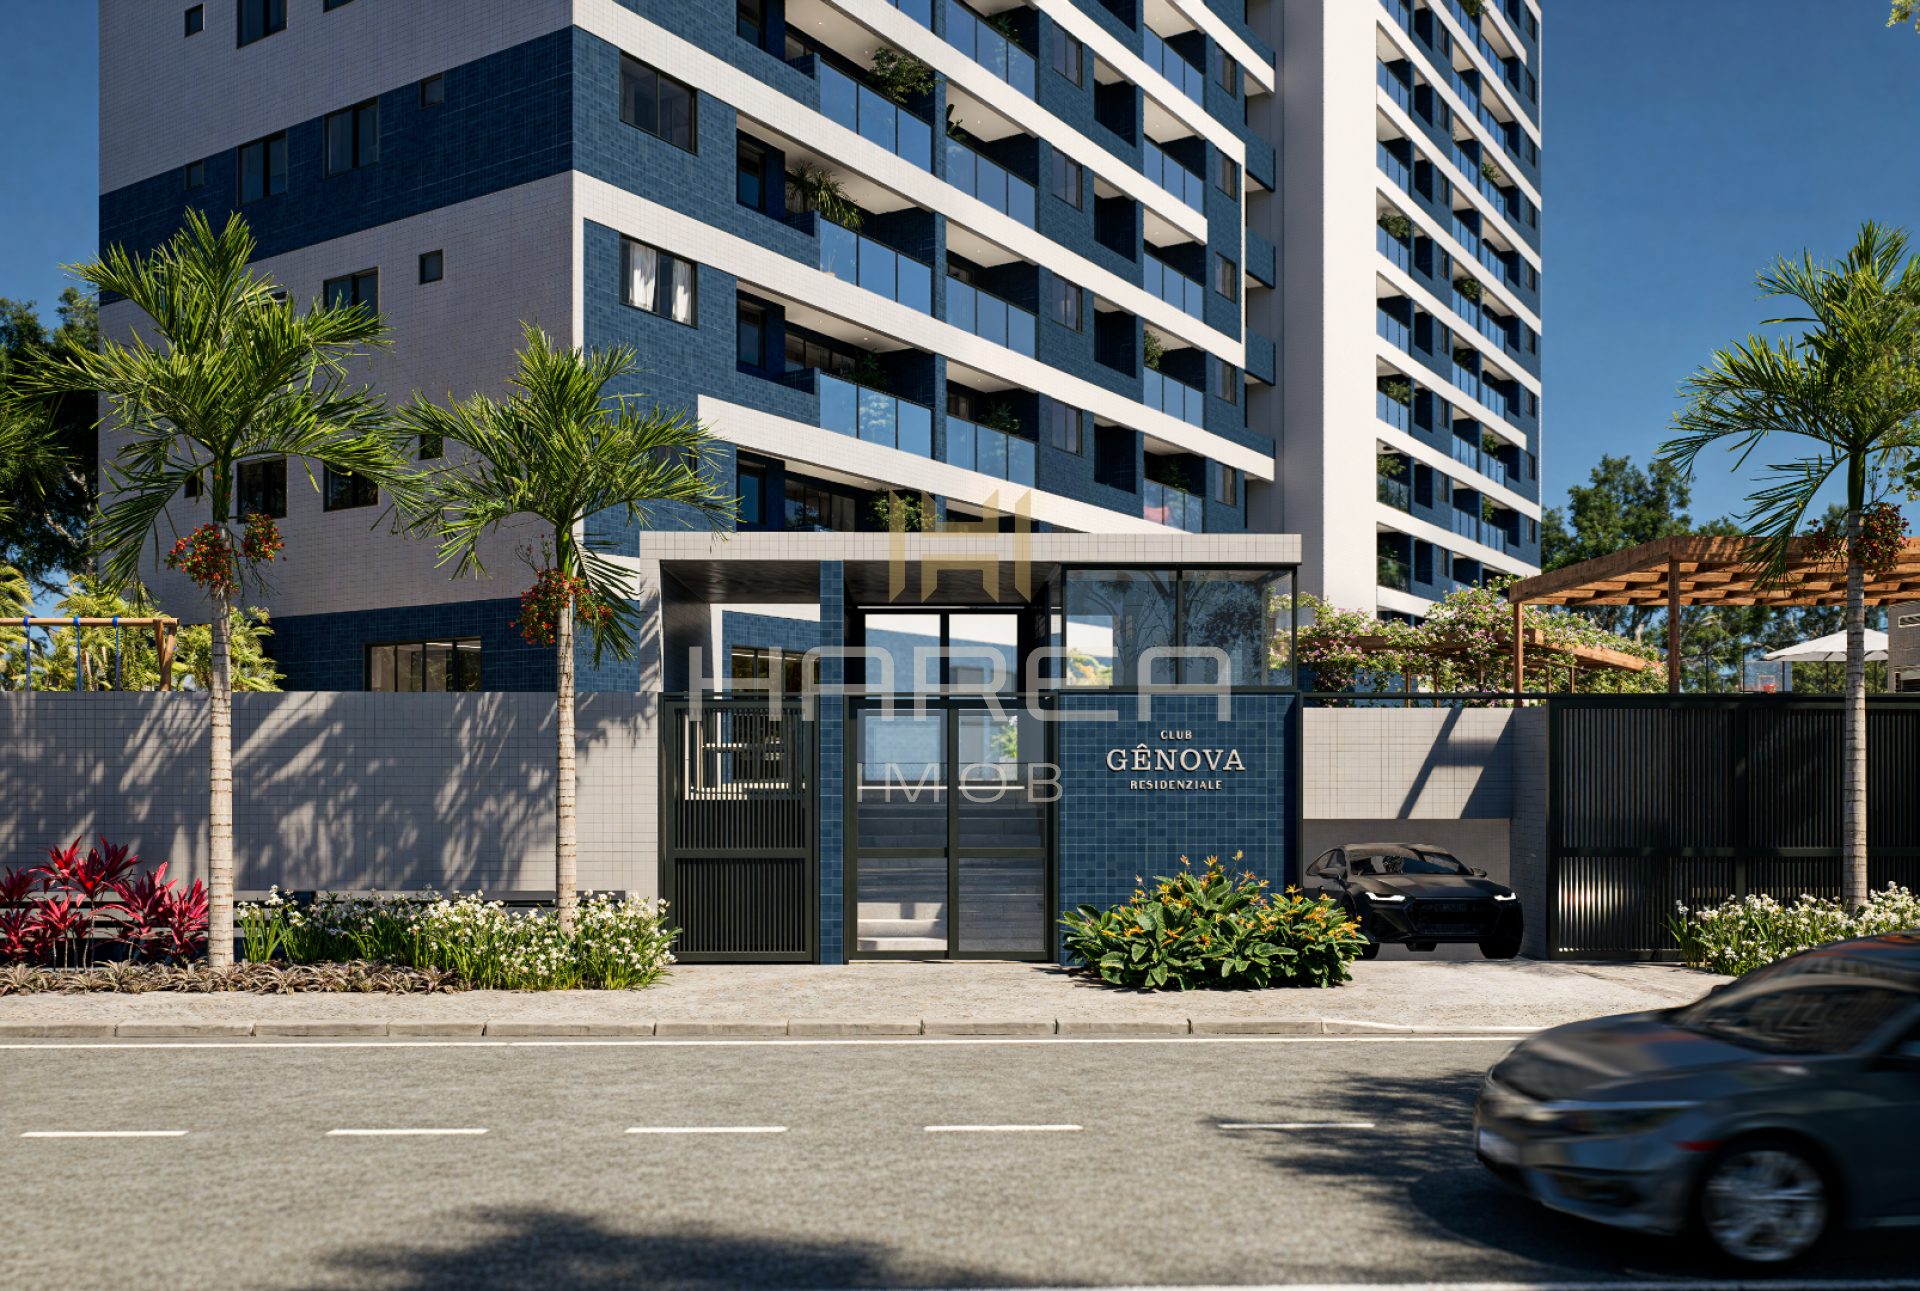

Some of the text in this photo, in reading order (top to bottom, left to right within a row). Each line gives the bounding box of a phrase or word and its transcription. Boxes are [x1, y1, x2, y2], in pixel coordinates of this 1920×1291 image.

[1160, 729, 1193, 740] CLUB
[1106, 743, 1246, 772] GÊNOVA
[1130, 780, 1223, 790] RESIDENZIALE
